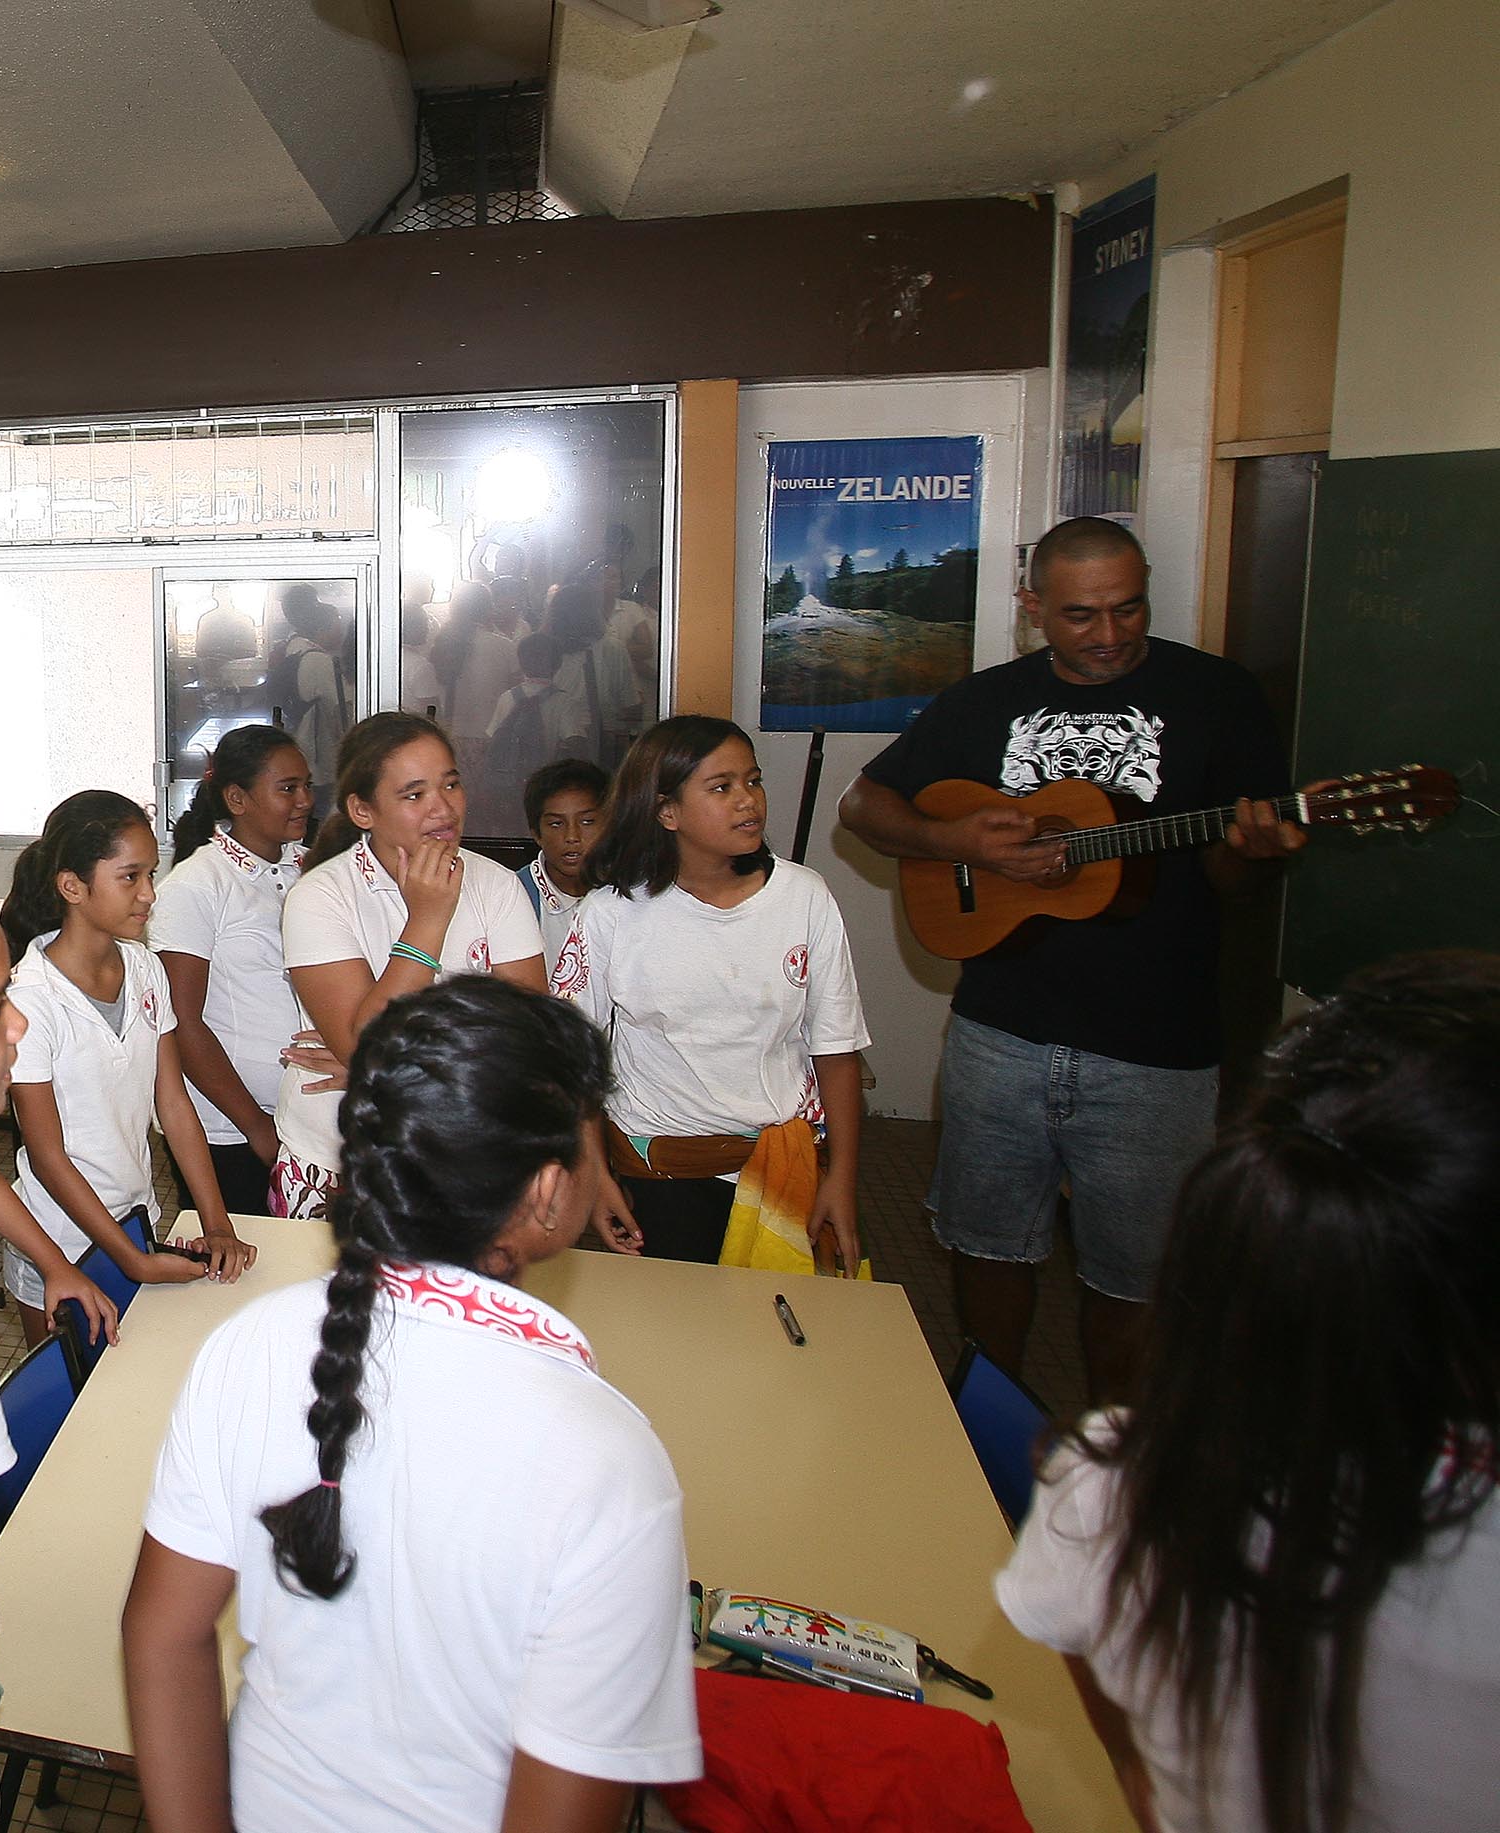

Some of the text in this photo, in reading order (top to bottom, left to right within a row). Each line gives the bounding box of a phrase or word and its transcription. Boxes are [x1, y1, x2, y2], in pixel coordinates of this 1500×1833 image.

[1095, 225, 1148, 274] SYDNEY
[774, 475, 971, 501] NOUVELLE ZELANDE
[858, 1648, 871, 1659] 48
[873, 1652, 887, 1663] 80
